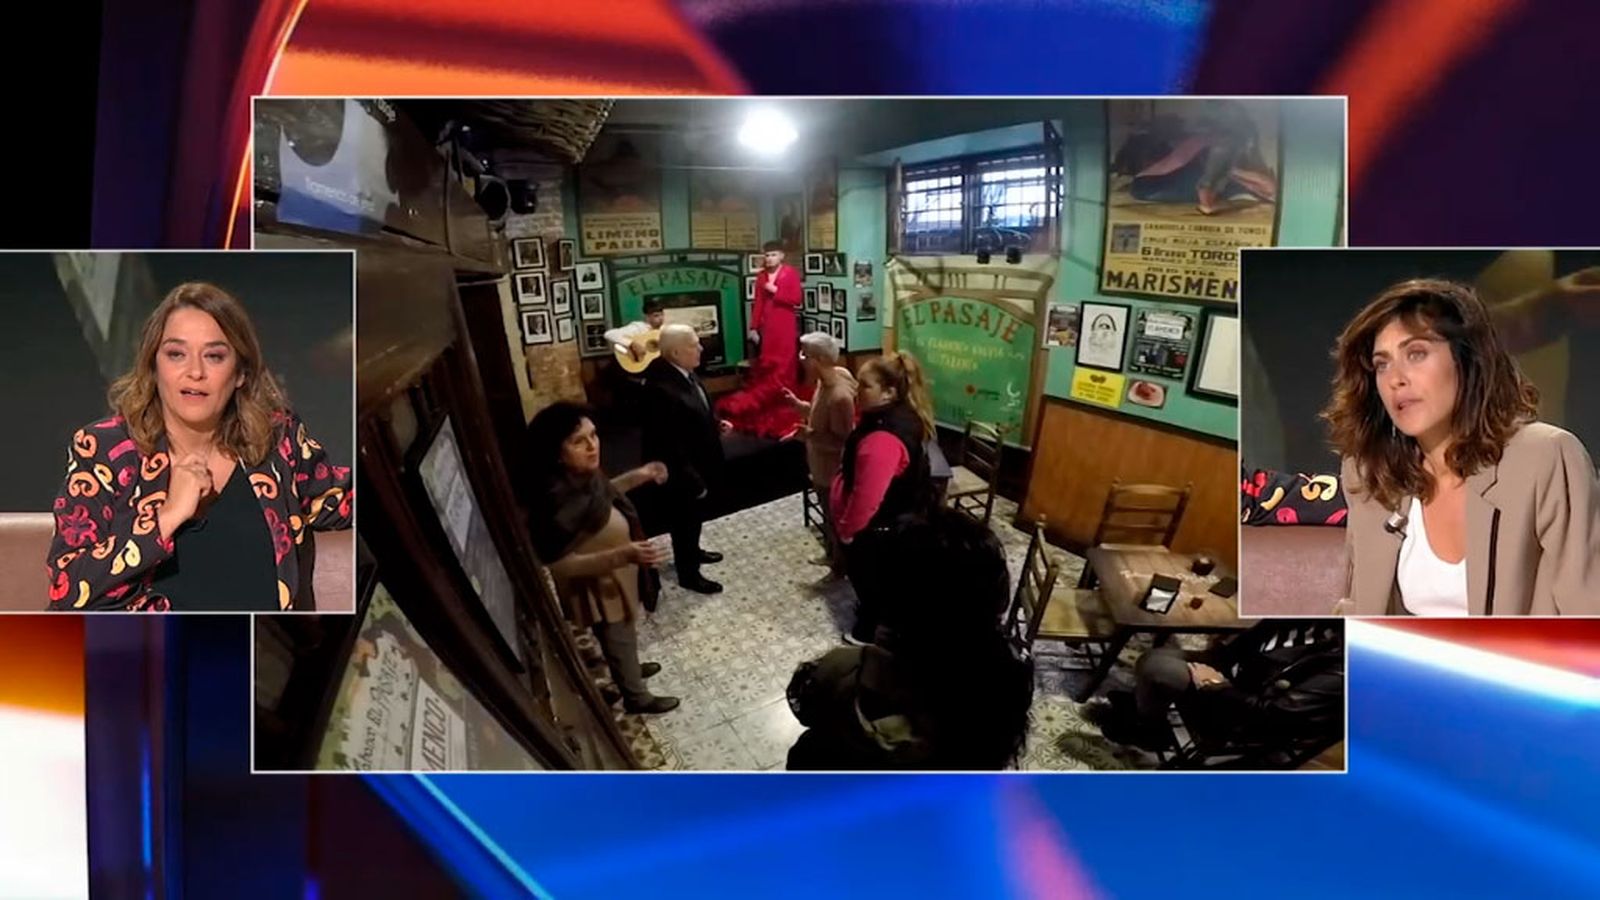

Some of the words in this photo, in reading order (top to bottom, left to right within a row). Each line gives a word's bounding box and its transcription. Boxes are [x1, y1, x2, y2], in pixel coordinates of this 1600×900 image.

[595, 240, 660, 250] PAULA
[1142, 247, 1151, 256] 6
[625, 277, 652, 296] EL
[902, 304, 926, 329] EL
[930, 300, 1023, 344] PASAJE
